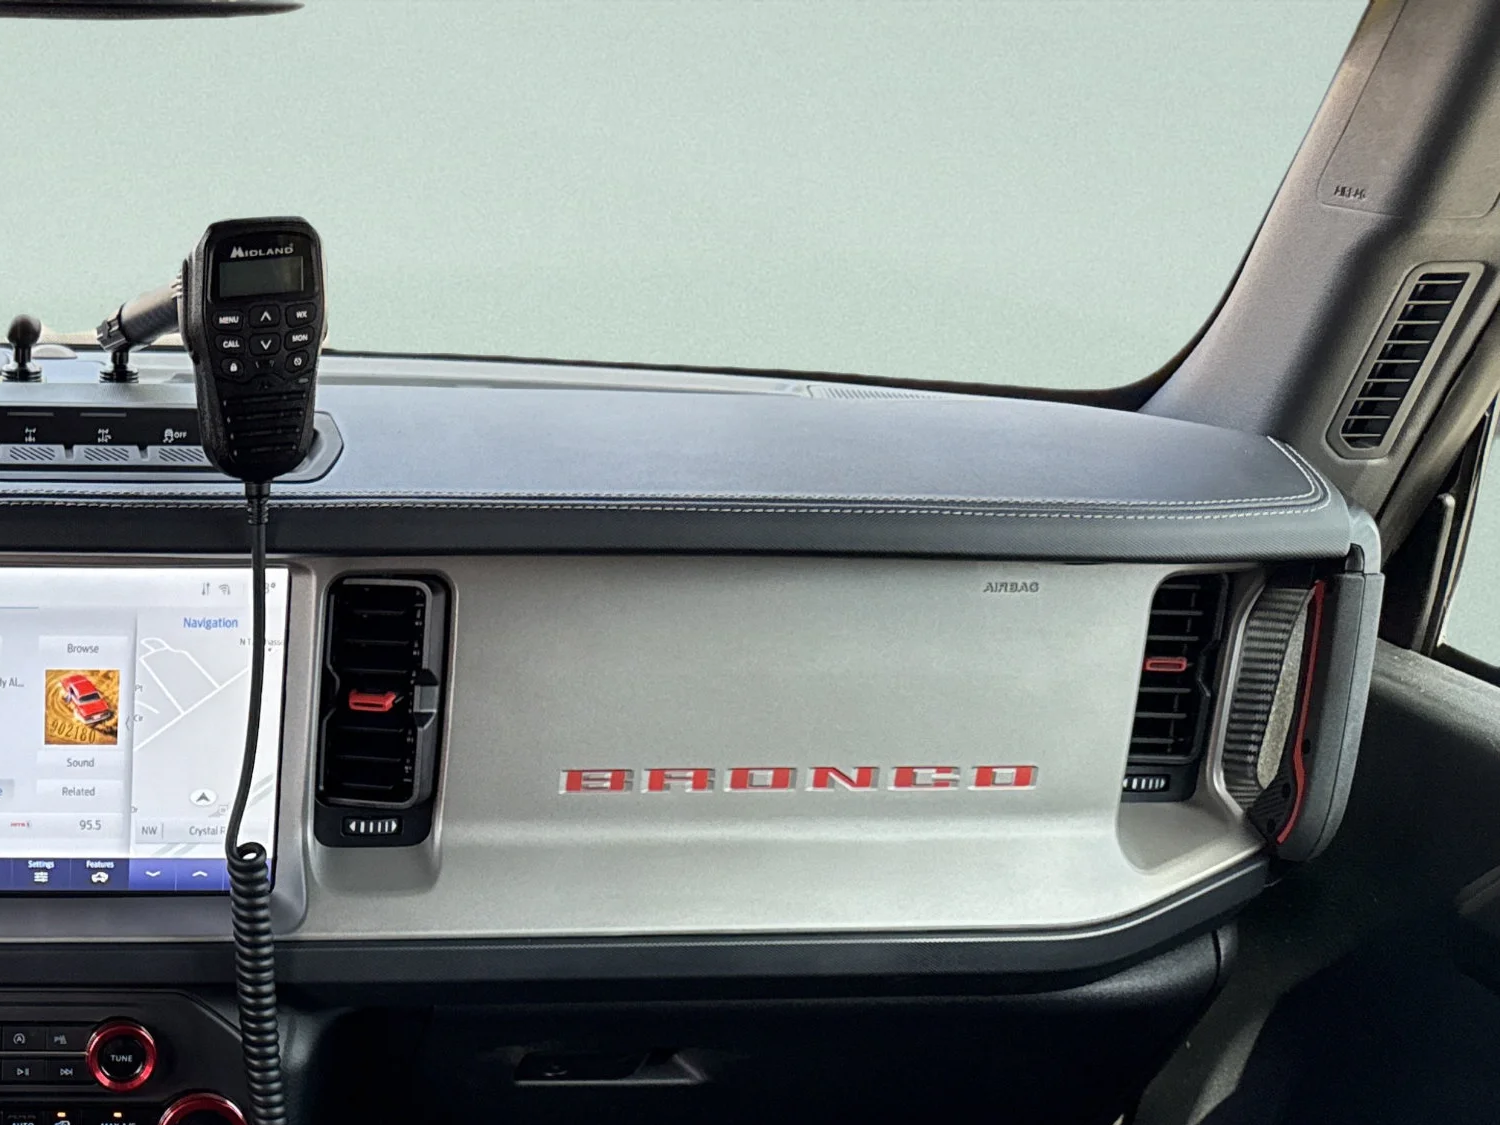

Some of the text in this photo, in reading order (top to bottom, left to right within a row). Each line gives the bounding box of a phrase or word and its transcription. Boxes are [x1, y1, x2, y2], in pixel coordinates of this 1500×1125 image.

[230, 244, 294, 259] MIDLAND
[218, 316, 239, 325] MENU
[292, 334, 308, 343] MON
[222, 340, 240, 349] CALL
[174, 431, 187, 439] OFF
[983, 581, 1040, 593] AIRBAG
[183, 617, 238, 630] Navigation
[67, 643, 99, 654] Browse
[50, 719, 96, 744] 902180
[66, 757, 95, 767] Sound
[558, 765, 1038, 794] BRONCO
[62, 786, 96, 797] Related
[79, 819, 102, 831] 95.5
[141, 826, 158, 836] NW
[189, 825, 218, 837] Crystal
[28, 860, 55, 870] Settings
[86, 860, 115, 869] Features
[110, 1054, 133, 1063] TUNE
